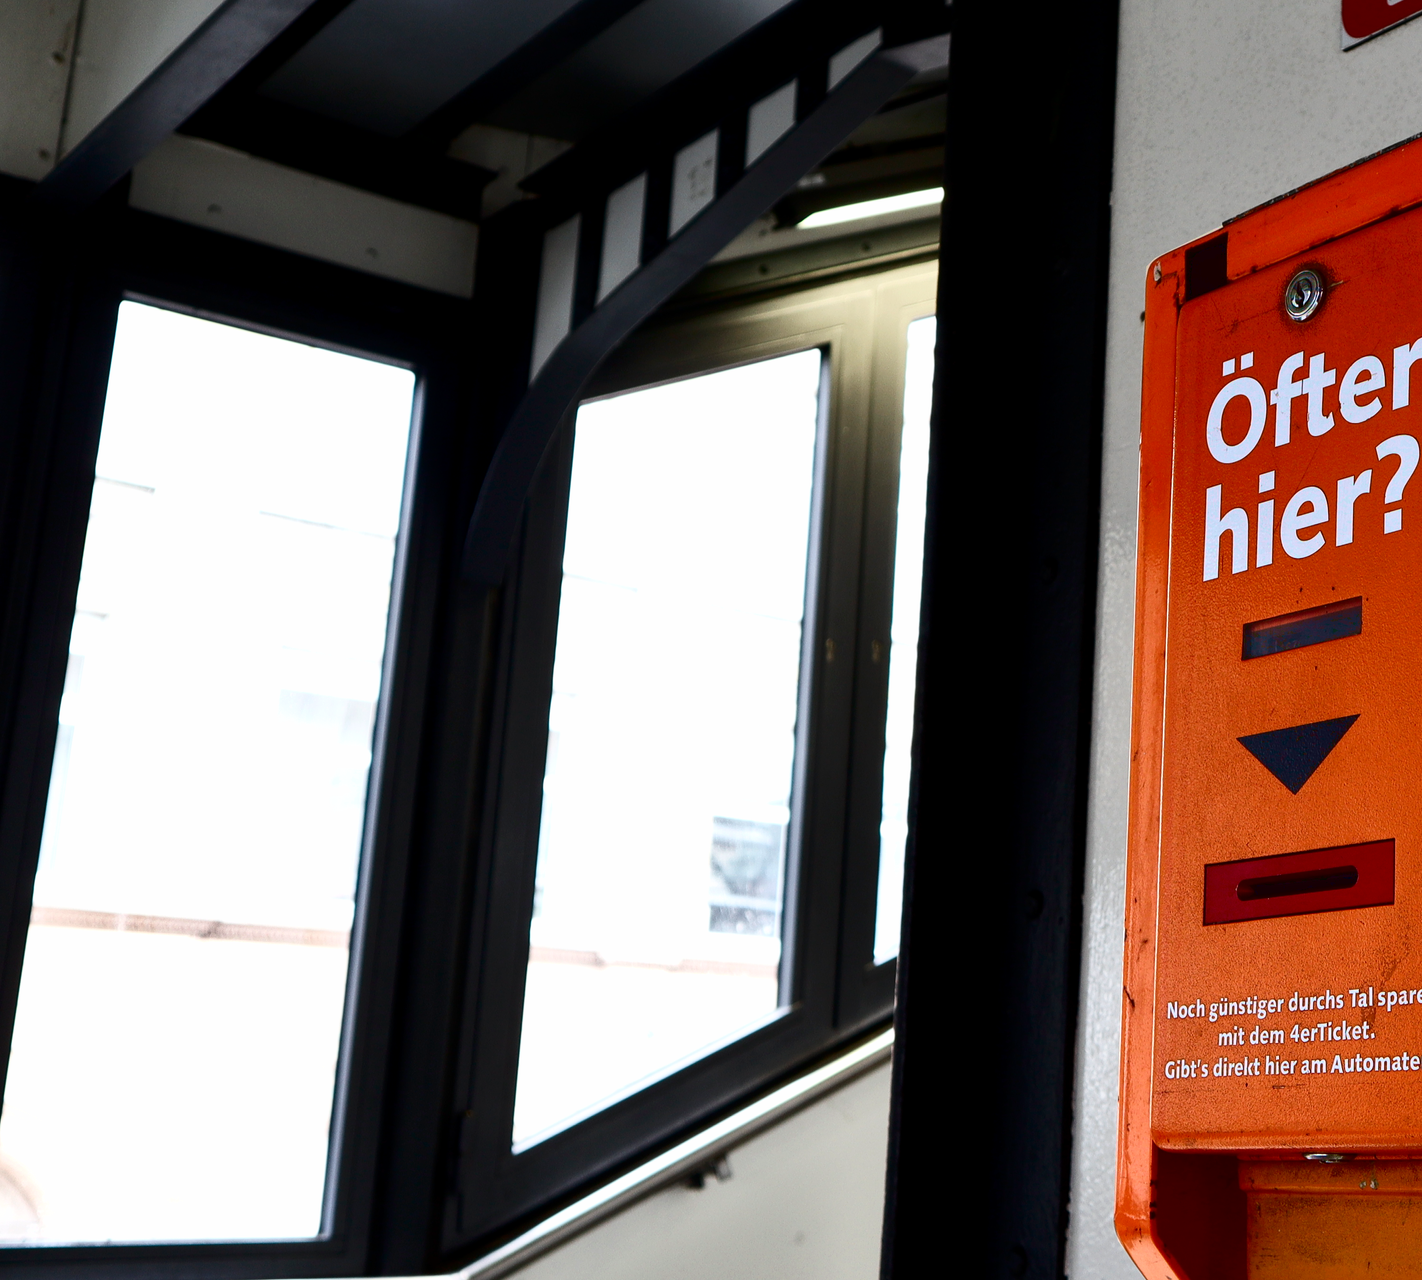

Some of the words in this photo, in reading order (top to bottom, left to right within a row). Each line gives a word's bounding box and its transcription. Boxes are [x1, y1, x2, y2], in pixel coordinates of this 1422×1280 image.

[1202, 434, 1420, 582] hier?
[1167, 998, 1205, 1020] Noch
[1208, 995, 1285, 1023] günstiger
[1288, 989, 1344, 1012] durchs
[1348, 986, 1373, 1008] Tal
[1218, 1028, 1245, 1047] mit
[1249, 1025, 1285, 1045] dem
[1289, 1020, 1376, 1043] 4erTicket.
[1164, 1059, 1209, 1080] Gibt's
[1212, 1056, 1261, 1078] direkt
[1265, 1055, 1298, 1075] hier
[1300, 1058, 1327, 1075] am
